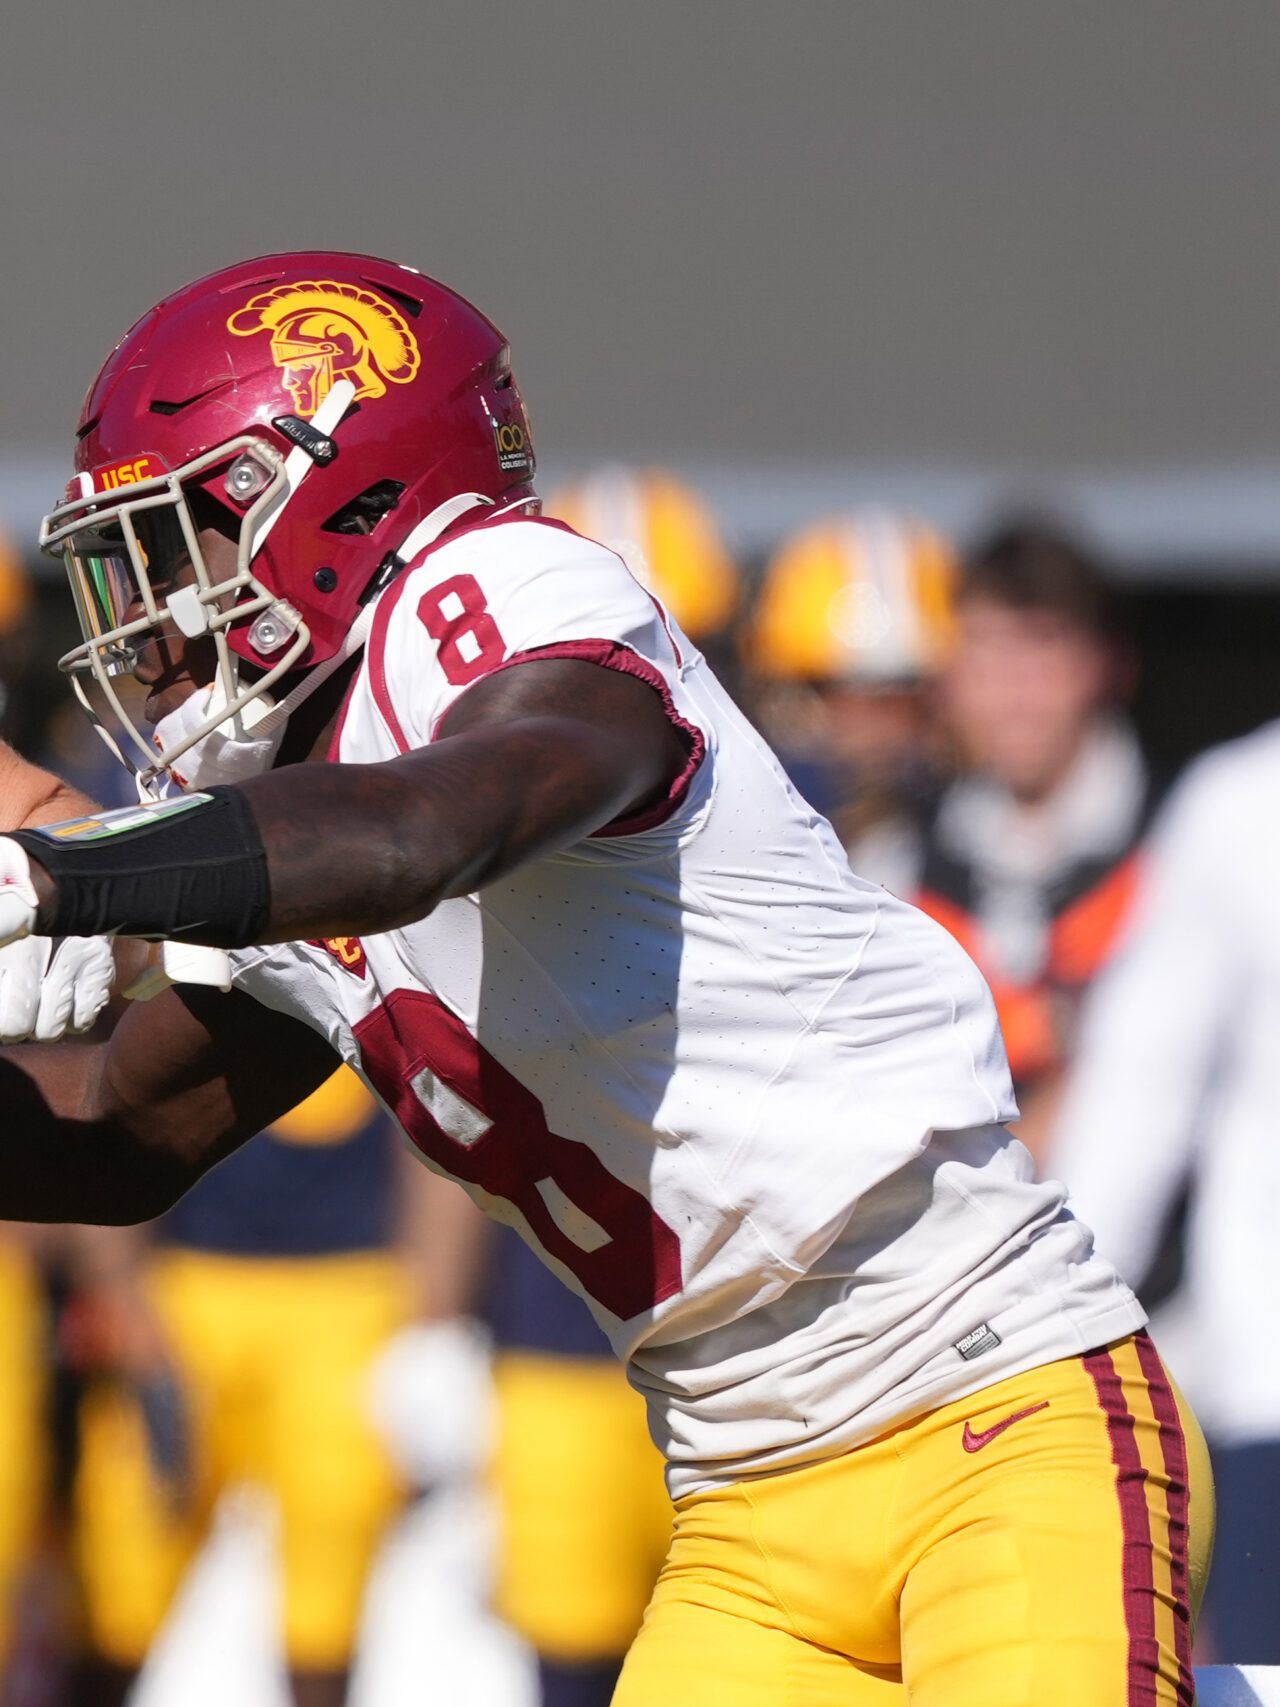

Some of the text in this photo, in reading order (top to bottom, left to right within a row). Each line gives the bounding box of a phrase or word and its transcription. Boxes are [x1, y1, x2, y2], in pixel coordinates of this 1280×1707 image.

[101, 459, 153, 491] USC
[416, 573, 507, 686] 8
[352, 987, 683, 1322] 8
